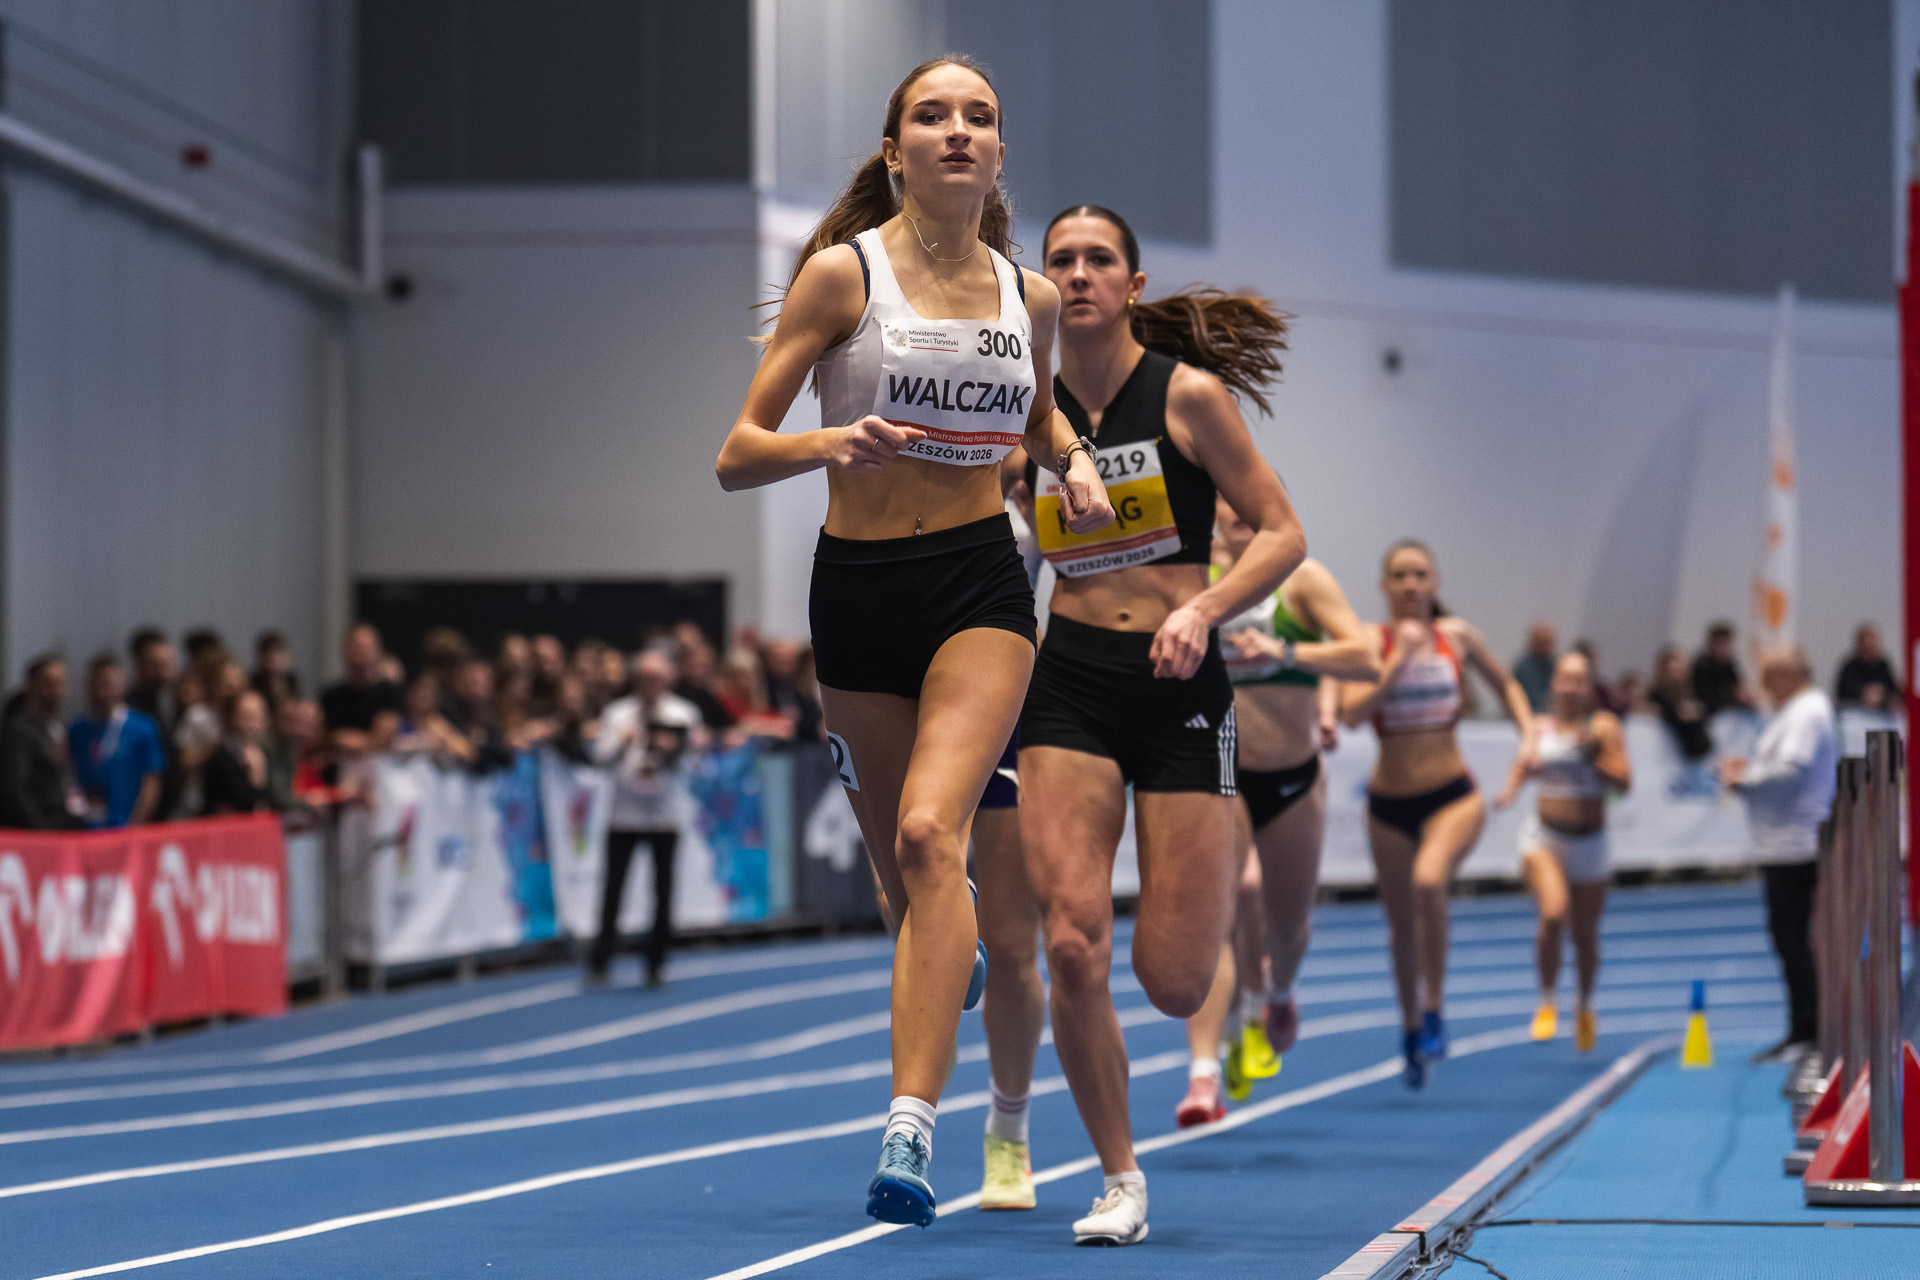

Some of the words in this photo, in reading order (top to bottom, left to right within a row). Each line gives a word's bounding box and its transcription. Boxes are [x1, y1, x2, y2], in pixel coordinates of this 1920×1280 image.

[908, 330, 947, 338] Ministerstwo
[909, 336, 929, 344] Sportu
[933, 338, 959, 347] Turystyki
[977, 328, 1021, 360] 300
[889, 374, 1031, 415] WALCZAK
[929, 430, 973, 443] Mistrzostwa
[974, 434, 989, 442] Polski
[990, 434, 1001, 442] U18
[1006, 436, 1020, 444] U20
[907, 441, 969, 461] ZESZÓW
[970, 448, 993, 461] 2026
[1096, 450, 1146, 479] 219
[1067, 553, 1124, 573] RZESZÓW
